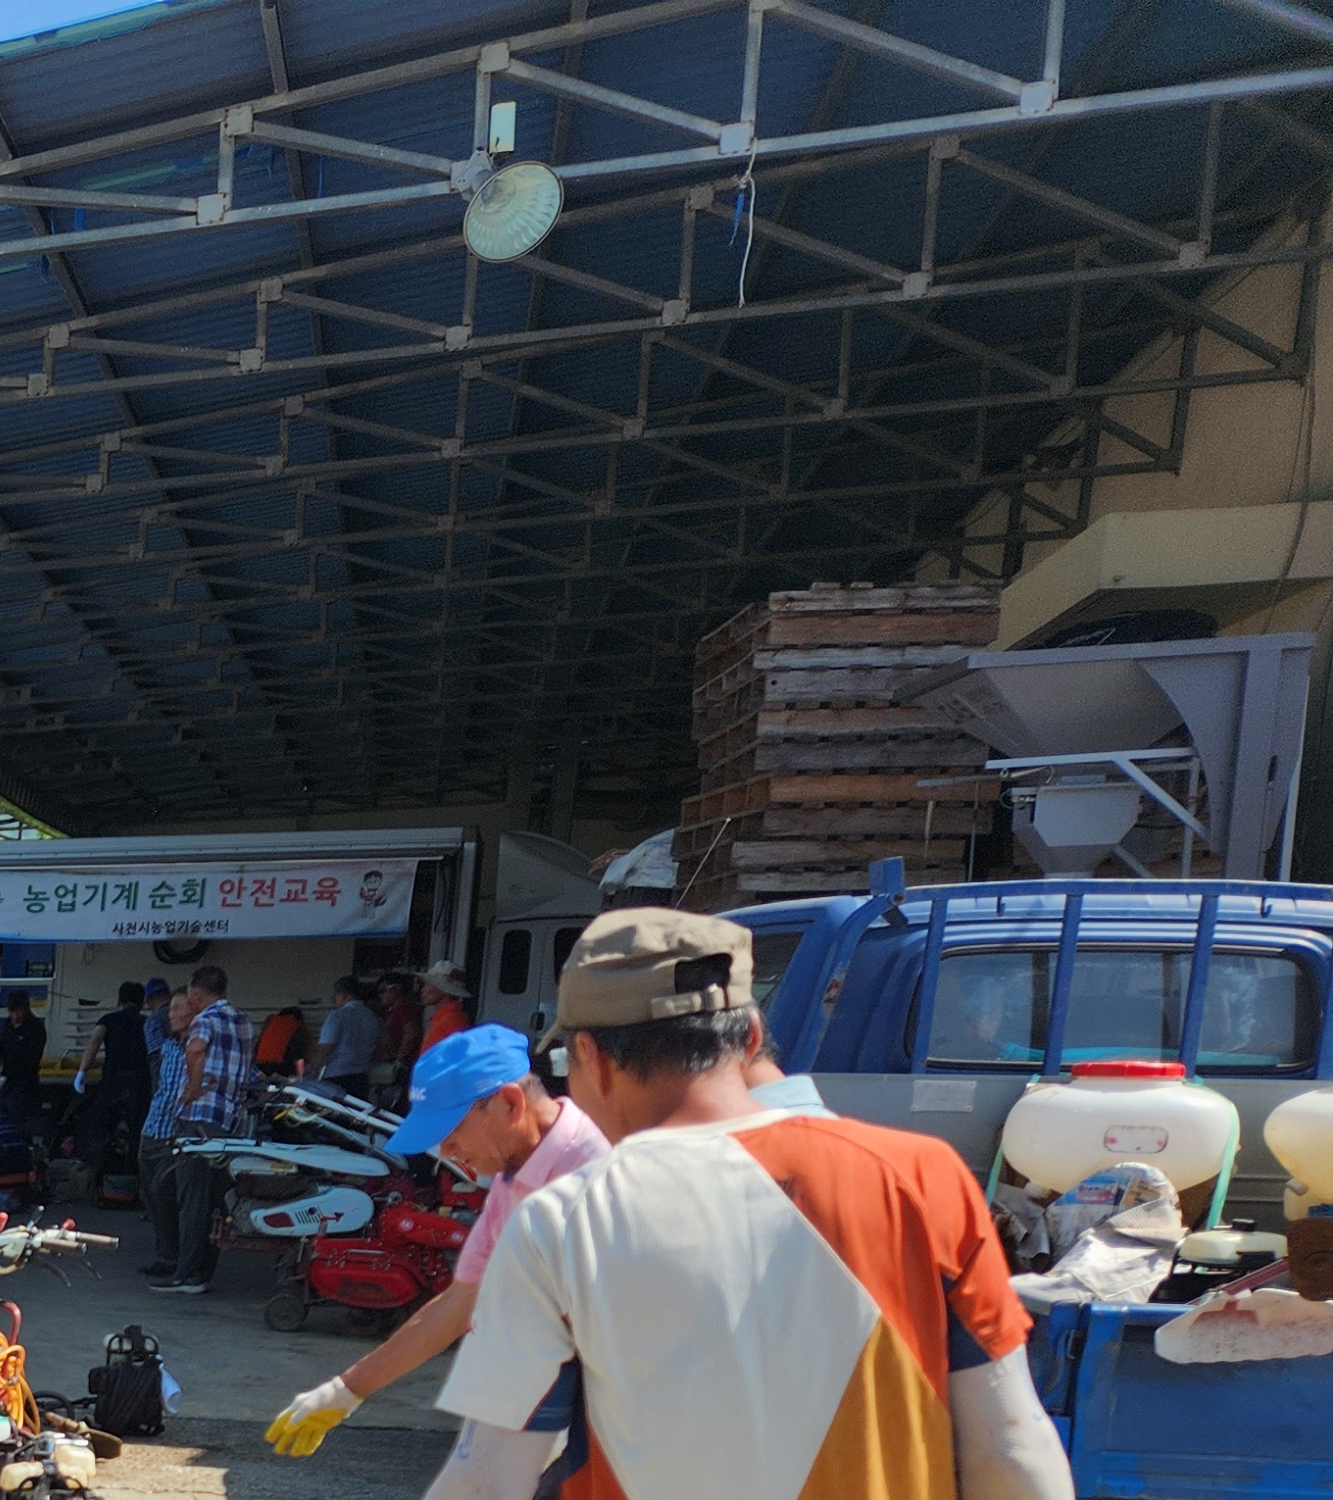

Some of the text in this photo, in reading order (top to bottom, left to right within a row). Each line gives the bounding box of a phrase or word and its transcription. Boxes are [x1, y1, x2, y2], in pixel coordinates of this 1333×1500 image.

[23, 876, 342, 913] 농업기계 순회 안전교육
